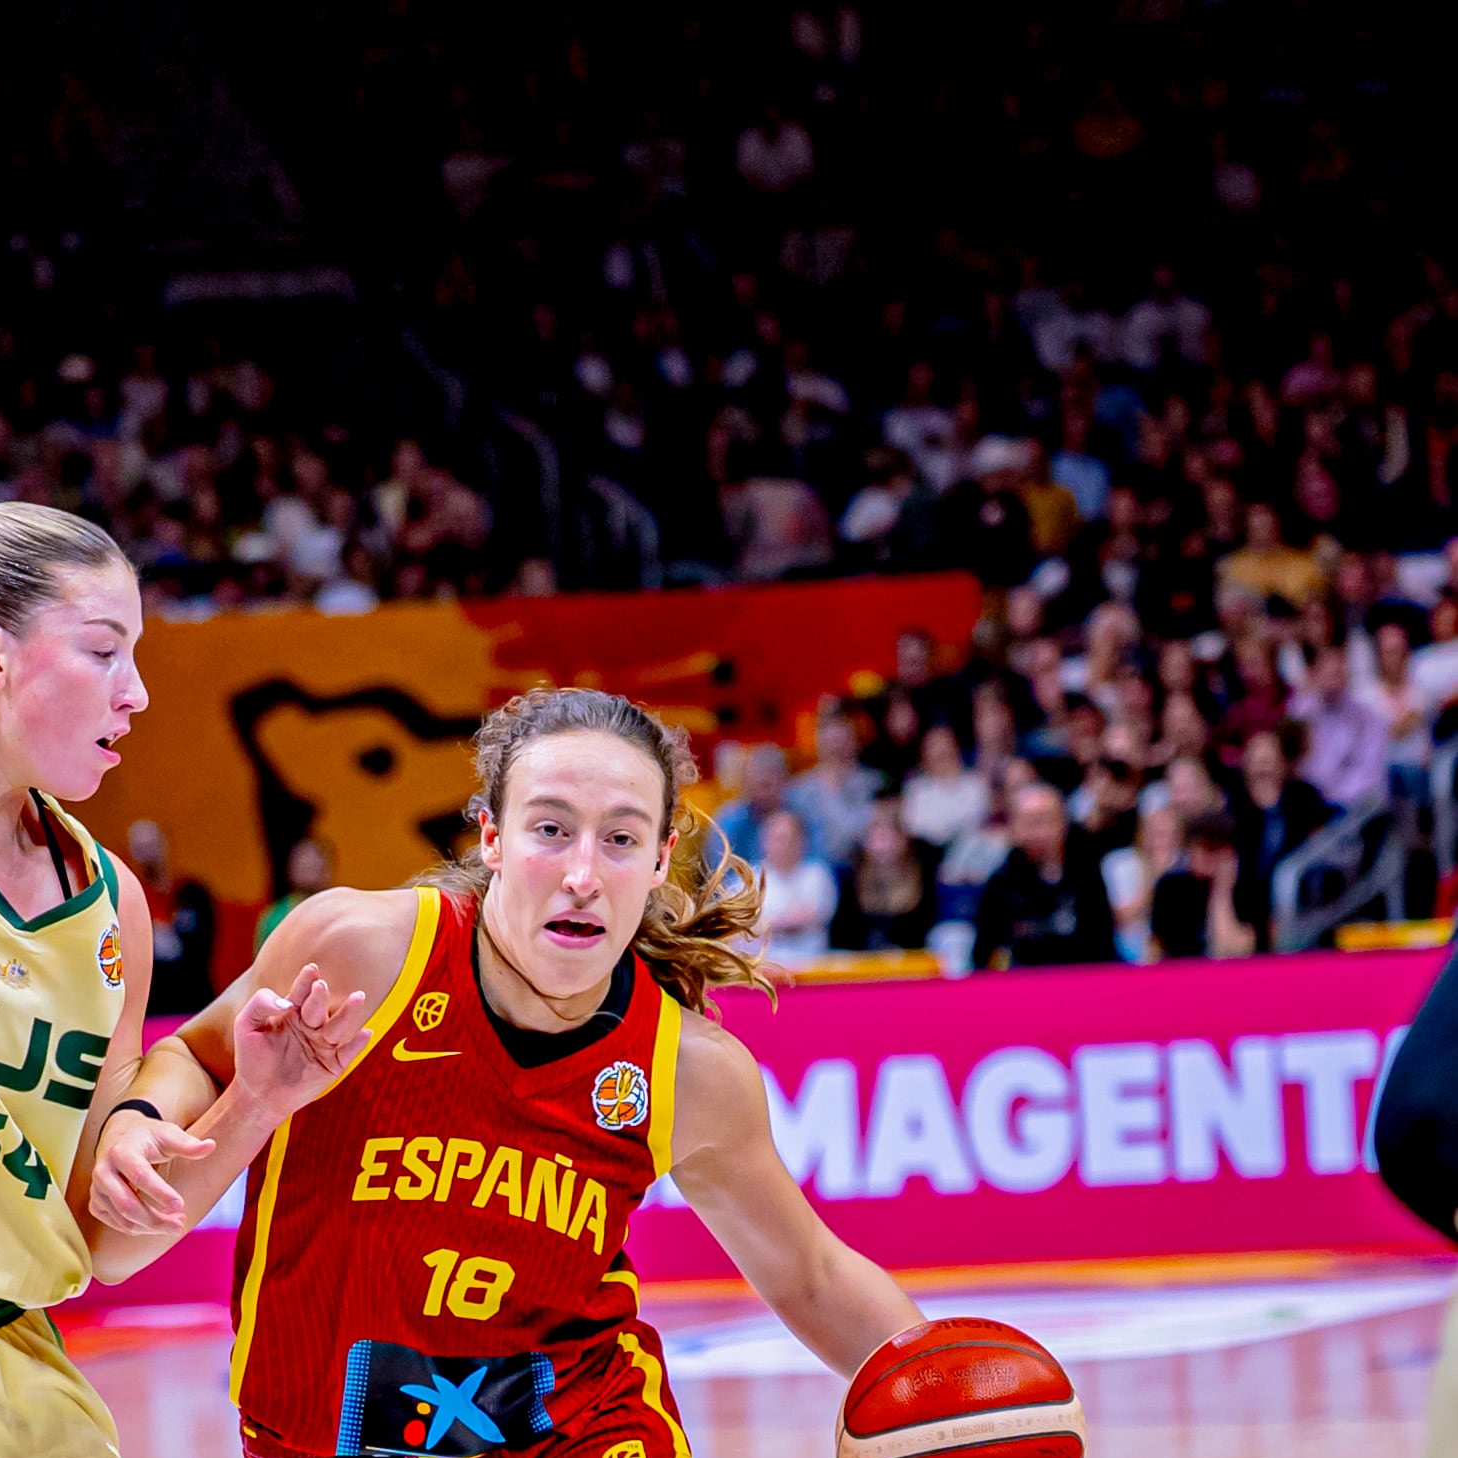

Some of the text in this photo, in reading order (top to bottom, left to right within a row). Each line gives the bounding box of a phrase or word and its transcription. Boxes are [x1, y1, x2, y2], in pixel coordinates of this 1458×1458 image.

[758, 1022, 1412, 1200] MAGENT
[352, 1135, 608, 1256] ESPAÑA
[422, 1247, 516, 1321] 18
